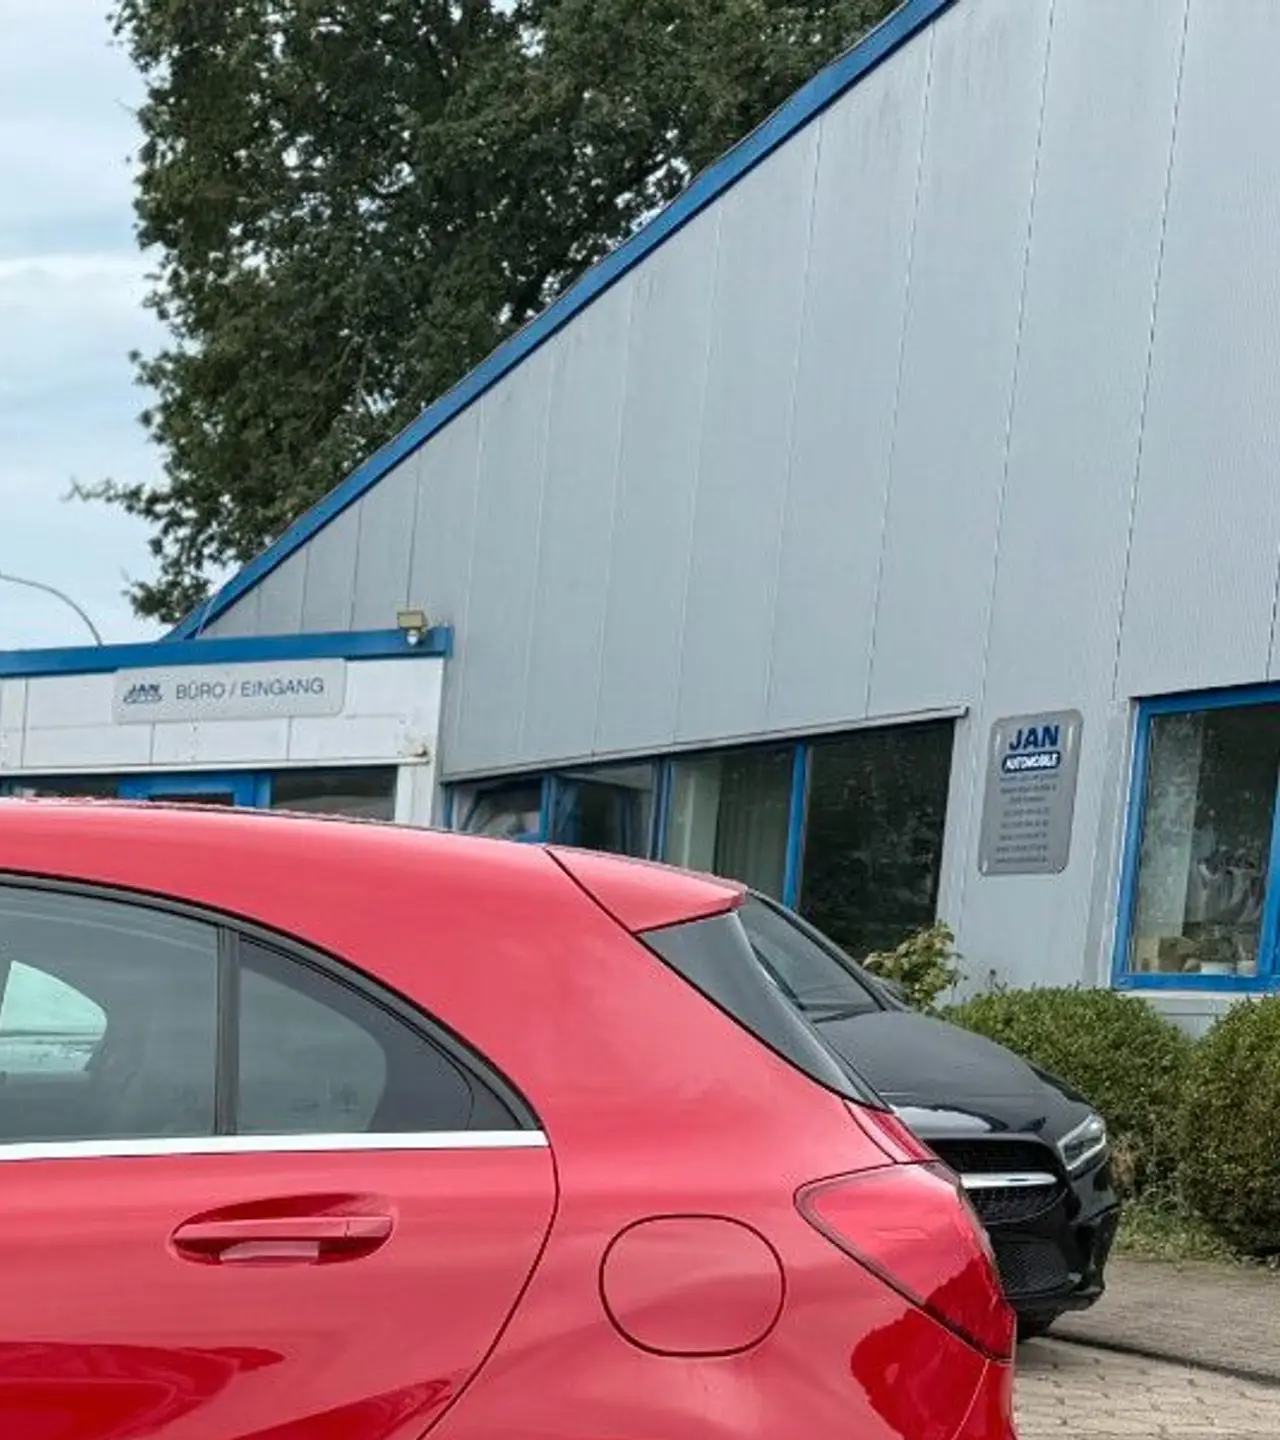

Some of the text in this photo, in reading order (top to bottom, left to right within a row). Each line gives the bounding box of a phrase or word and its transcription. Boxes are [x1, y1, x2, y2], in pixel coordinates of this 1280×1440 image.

[175, 680, 226, 700] BÜRO
[241, 677, 325, 698] EINGANG
[1009, 725, 1060, 751] JAN
